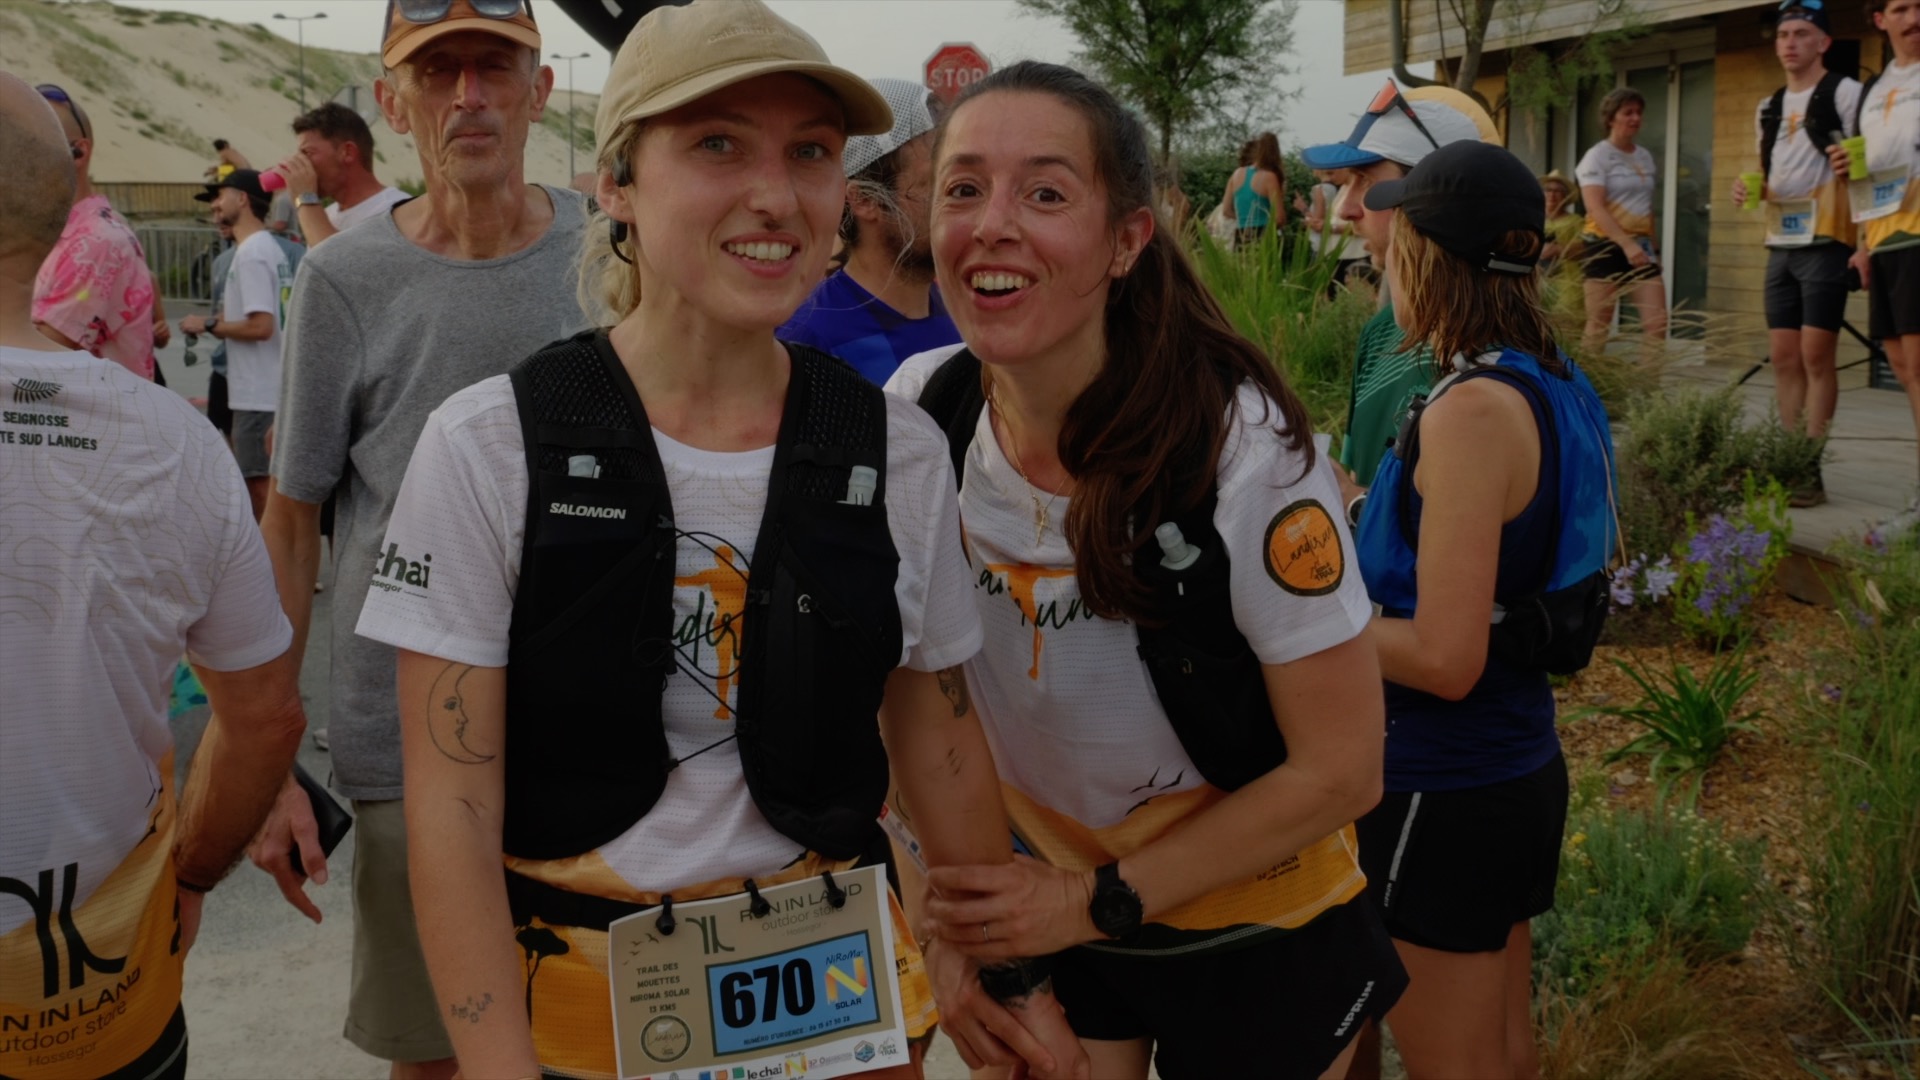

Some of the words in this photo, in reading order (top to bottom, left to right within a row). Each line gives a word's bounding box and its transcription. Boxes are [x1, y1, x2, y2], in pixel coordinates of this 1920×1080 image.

[930, 67, 984, 87] STOP
[3, 411, 69, 427] SEIGNOSSE
[19, 433, 43, 446] SUD
[48, 434, 97, 450] LANDES
[549, 502, 627, 519] SALOMON
[740, 901, 780, 923] RN
[785, 895, 804, 911] IN
[762, 910, 809, 931] outdoor
[636, 966, 660, 976] TRAIL
[663, 962, 679, 972] DES
[637, 976, 681, 989] MOUETTES
[40, 1003, 70, 1028] IN
[78, 966, 141, 1016] LAND
[630, 991, 661, 1003] NIROMA
[664, 988, 690, 997] SOLAR
[719, 958, 815, 1028] 670
[660, 1003, 676, 1013] KMS
[835, 997, 862, 1010] SOLAR
[1334, 981, 1375, 1036] KIPRUN
[86, 1000, 127, 1035] store
[747, 1069, 758, 1080] le
[759, 1063, 783, 1079] chai
